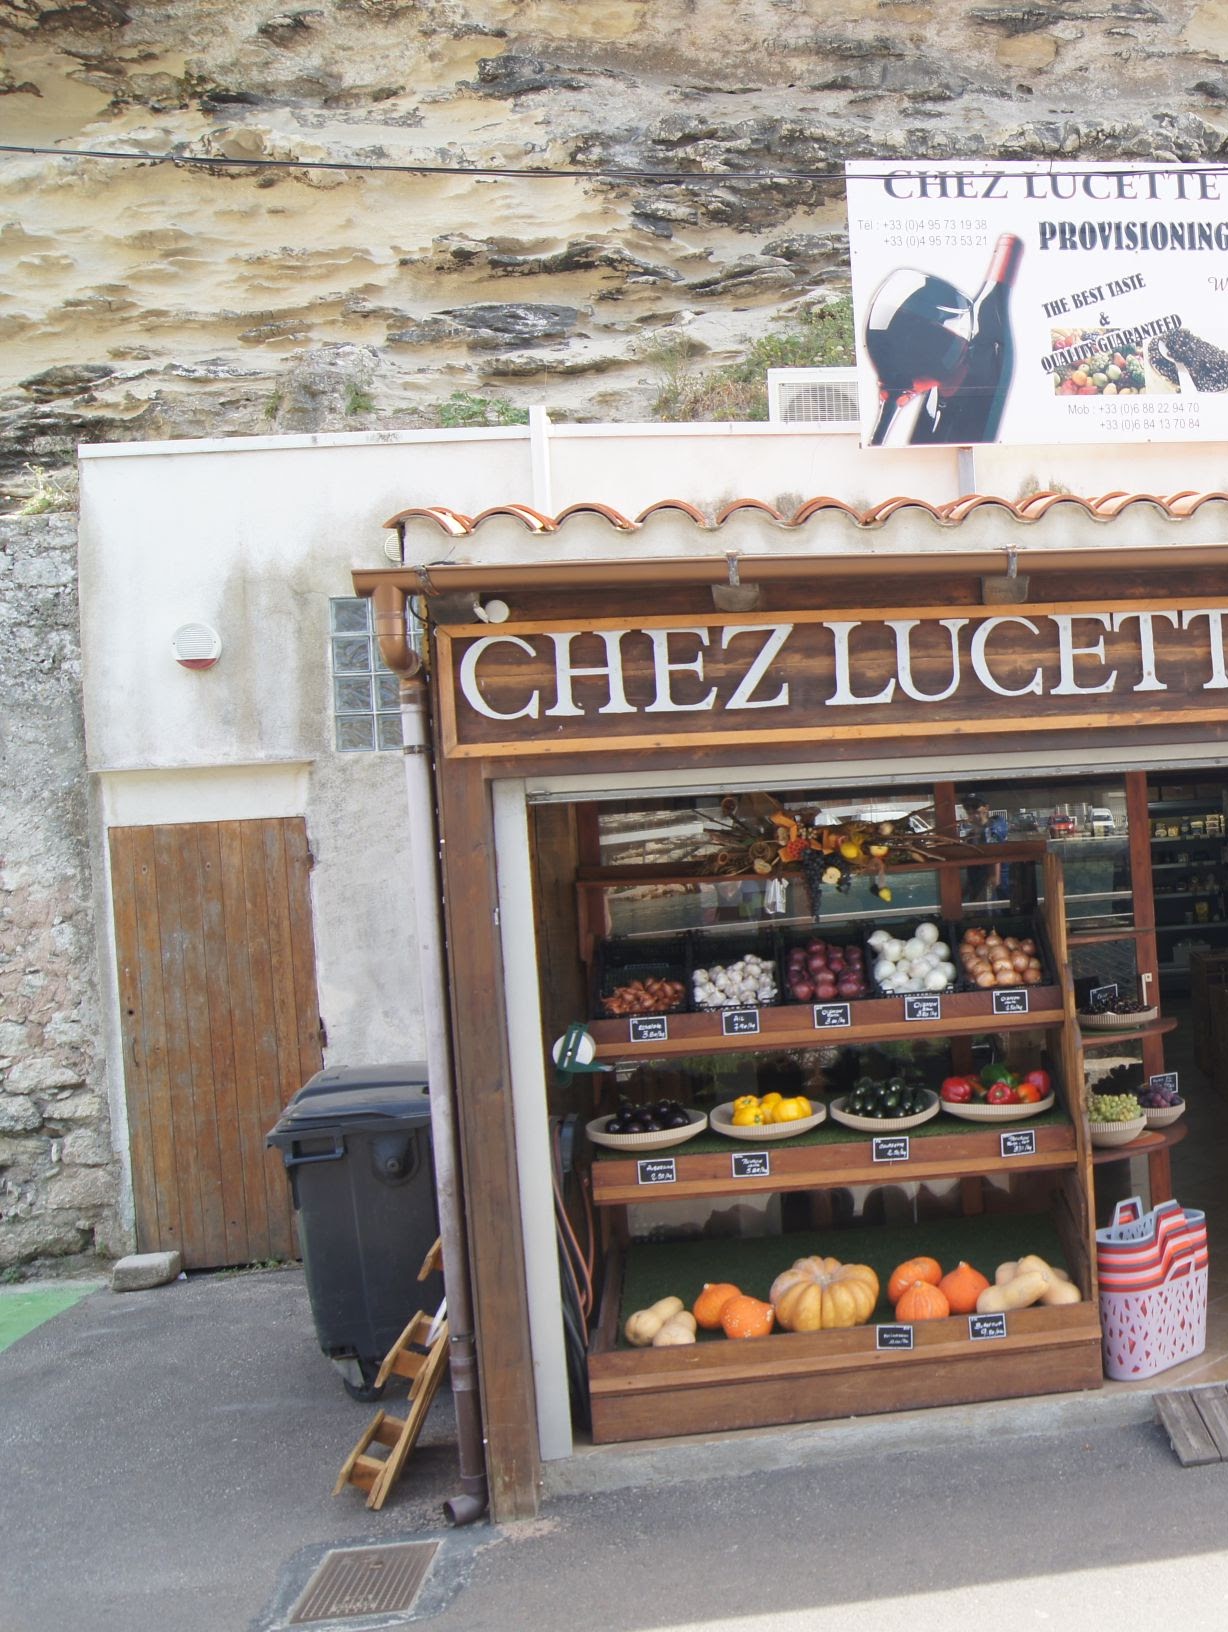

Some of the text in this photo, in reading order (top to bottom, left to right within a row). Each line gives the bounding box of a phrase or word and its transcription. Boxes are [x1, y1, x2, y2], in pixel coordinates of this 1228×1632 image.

[883, 169, 1008, 199] CHEZ
[1022, 170, 1221, 200] LUCETTE
[857, 219, 873, 231] Tel
[883, 219, 902, 231] +33
[905, 219, 924, 232] (0)4
[928, 219, 941, 230] 95
[944, 219, 957, 230] 73
[960, 219, 972, 230] 19
[975, 219, 988, 230] 38
[884, 235, 987, 248] +33 (0)4 95 73 53 21
[1041, 272, 1147, 318] THE BEST TASTE
[1099, 311, 1111, 327] &
[1040, 313, 1183, 375] QUALITY GUARANTEED
[1067, 403, 1090, 415] Mob
[1099, 403, 1117, 414] +33
[1142, 402, 1155, 414] 88
[1158, 402, 1169, 414] 22
[1172, 402, 1184, 414] 94
[1187, 402, 1200, 413] 70
[1100, 419, 1119, 431] +33
[1143, 419, 1155, 430] 84
[1159, 418, 1171, 430] 13
[1173, 418, 1186, 429] 70
[1188, 418, 1200, 429] 84
[460, 623, 794, 720] CHEZ
